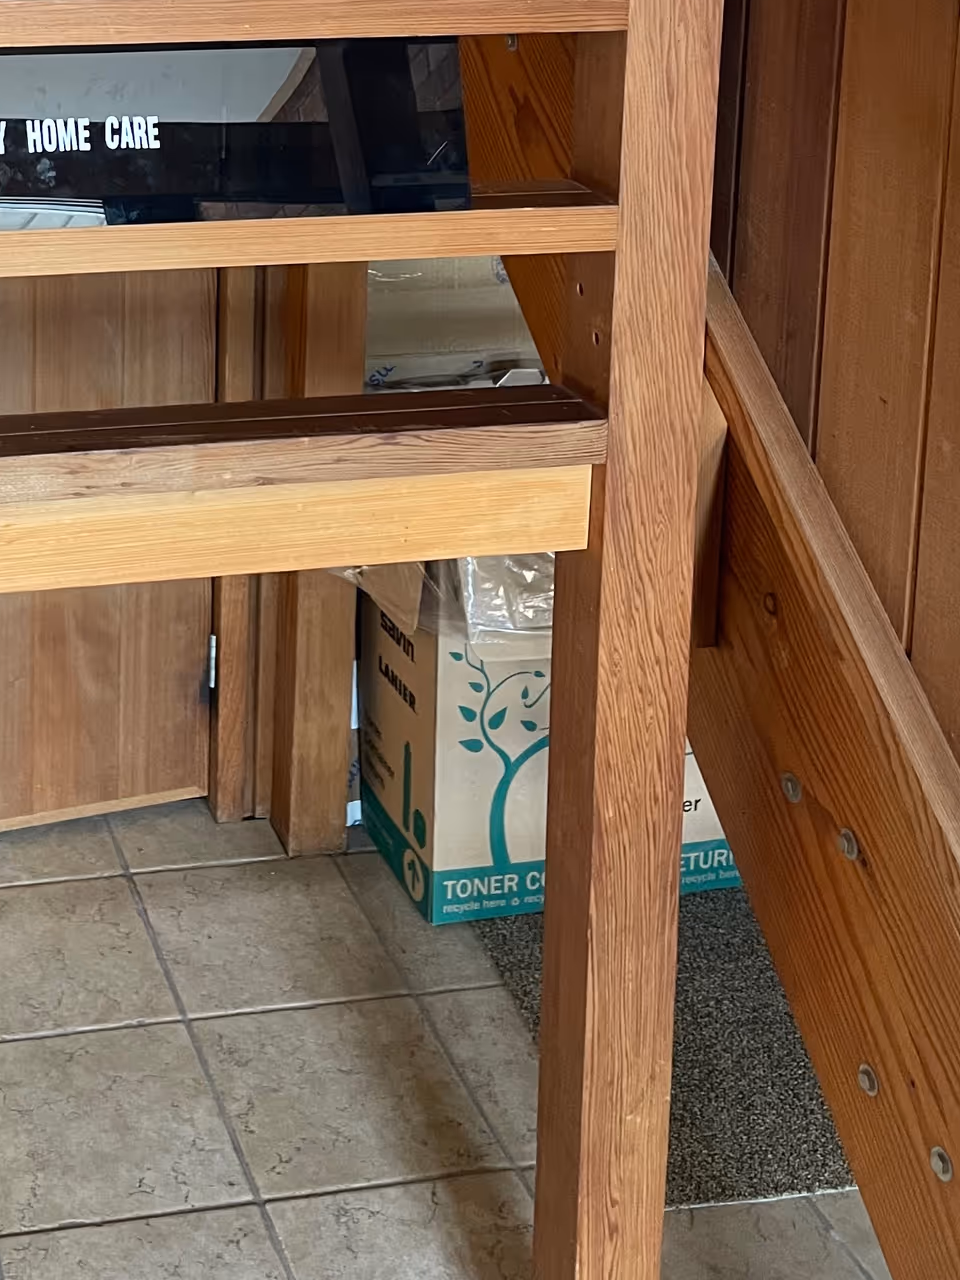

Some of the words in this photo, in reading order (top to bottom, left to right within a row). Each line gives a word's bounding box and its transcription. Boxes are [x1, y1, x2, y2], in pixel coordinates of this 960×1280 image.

[25, 117, 91, 154] HOME
[105, 115, 161, 150] CARE
[378, 653, 417, 714] LANIER
[443, 873, 519, 900] TONER
